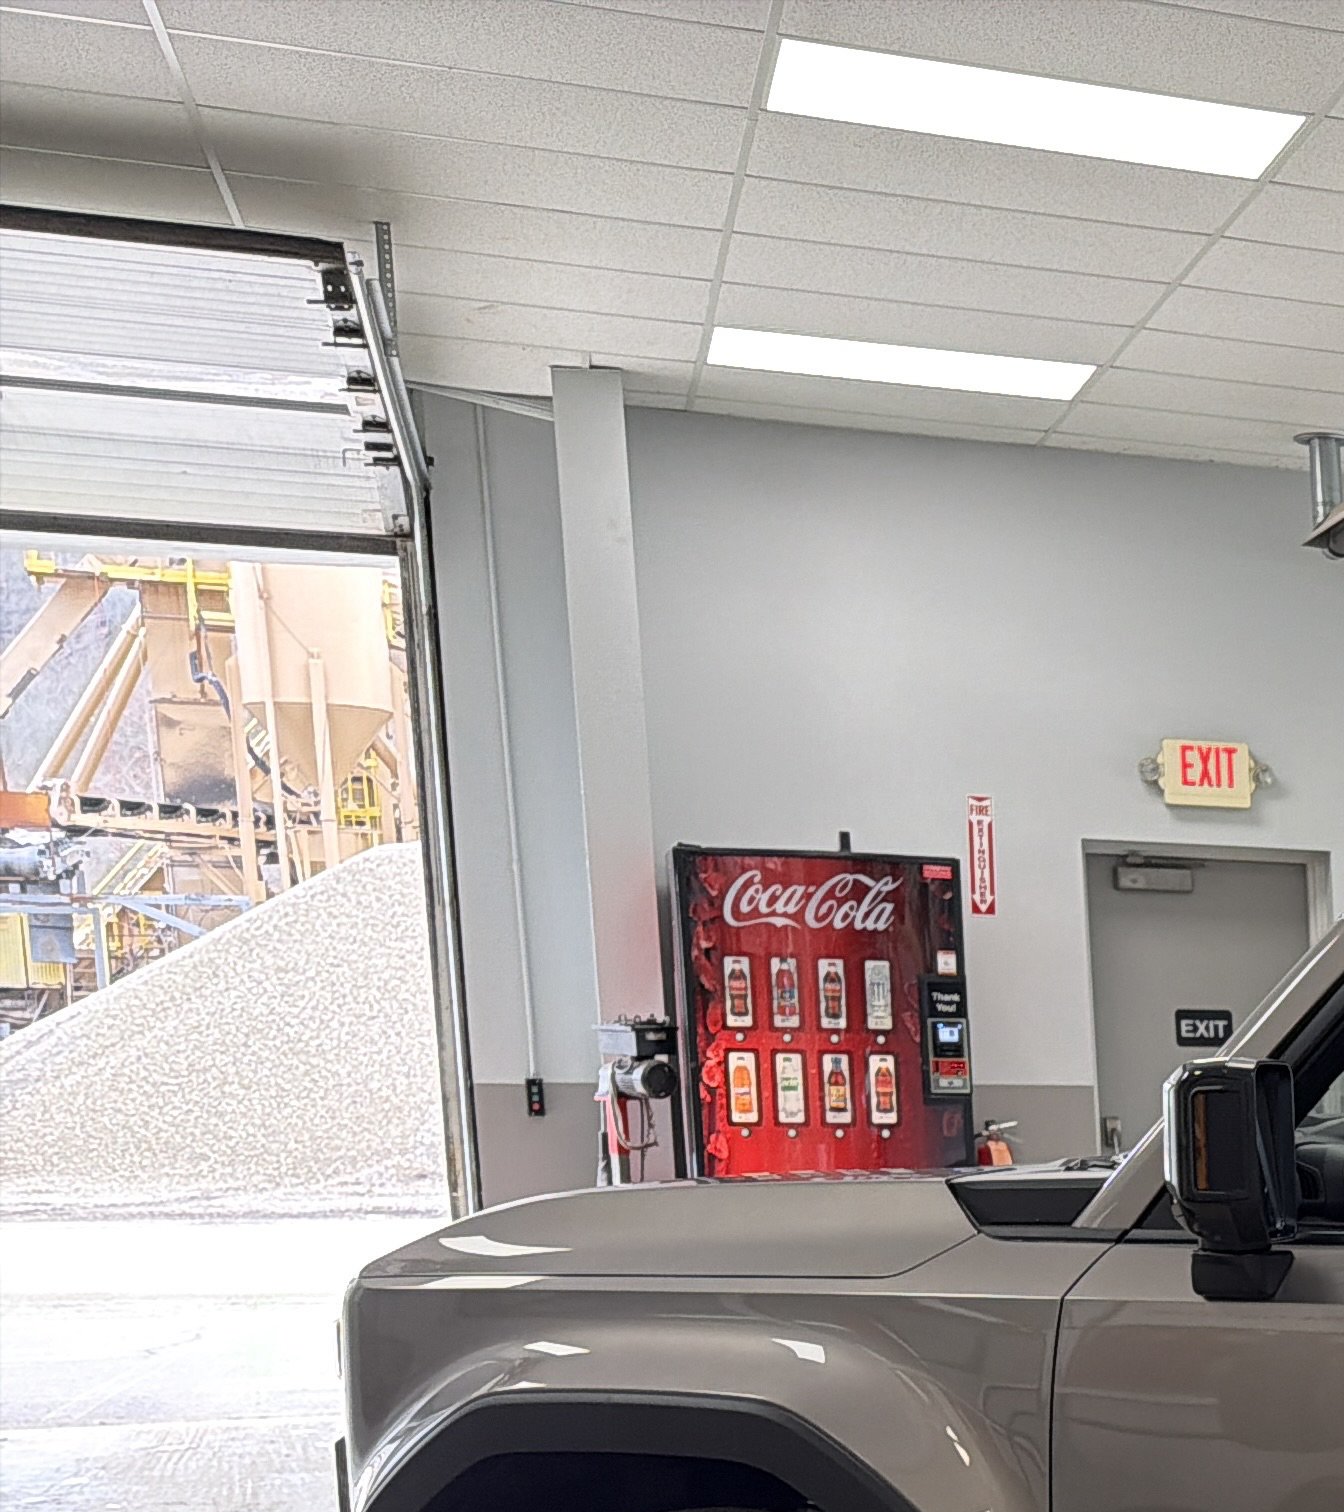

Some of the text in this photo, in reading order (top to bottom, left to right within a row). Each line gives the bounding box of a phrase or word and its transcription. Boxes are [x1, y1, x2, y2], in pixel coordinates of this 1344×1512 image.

[1180, 744, 1238, 789] EXIT
[969, 804, 990, 816] FIRE
[723, 869, 904, 932] Coca-Cola
[931, 991, 961, 1003] Thank
[935, 1003, 957, 1013] You!
[1180, 1019, 1229, 1038] EXIT
